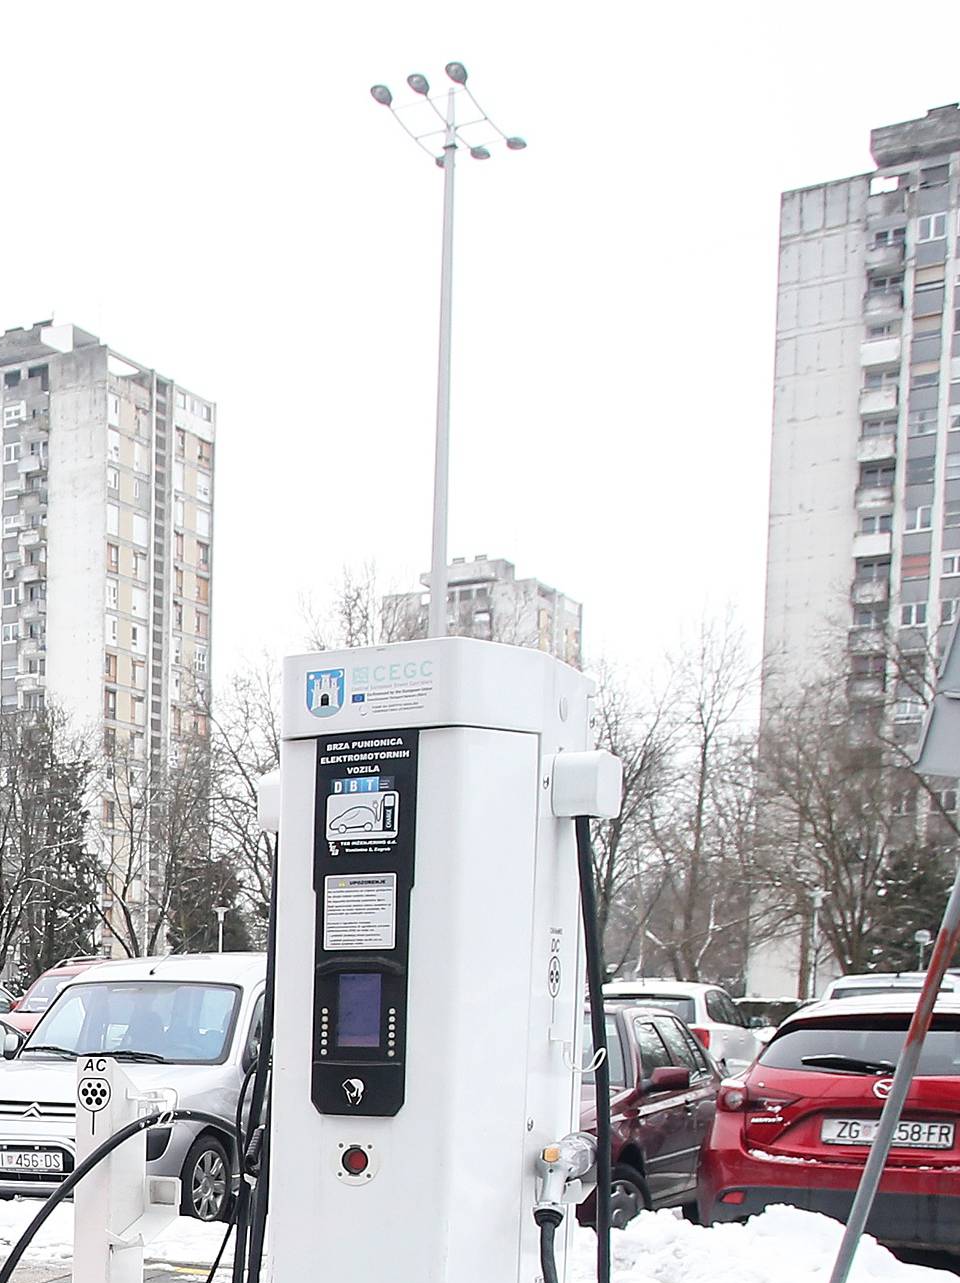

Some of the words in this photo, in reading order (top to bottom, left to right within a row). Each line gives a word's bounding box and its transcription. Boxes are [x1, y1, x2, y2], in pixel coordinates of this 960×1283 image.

[373, 660, 433, 681] CEGC
[326, 742, 350, 751] BRZA
[351, 738, 403, 749] PUNIONICA
[320, 750, 410, 764] ELEKTROMOTORNIH
[346, 765, 380, 774] VOZILA
[83, 1058, 107, 1072] AC
[836, 1121, 860, 1139] ZG
[874, 1122, 951, 1142] 58-FR
[15, 1153, 61, 1168] 456-DS
